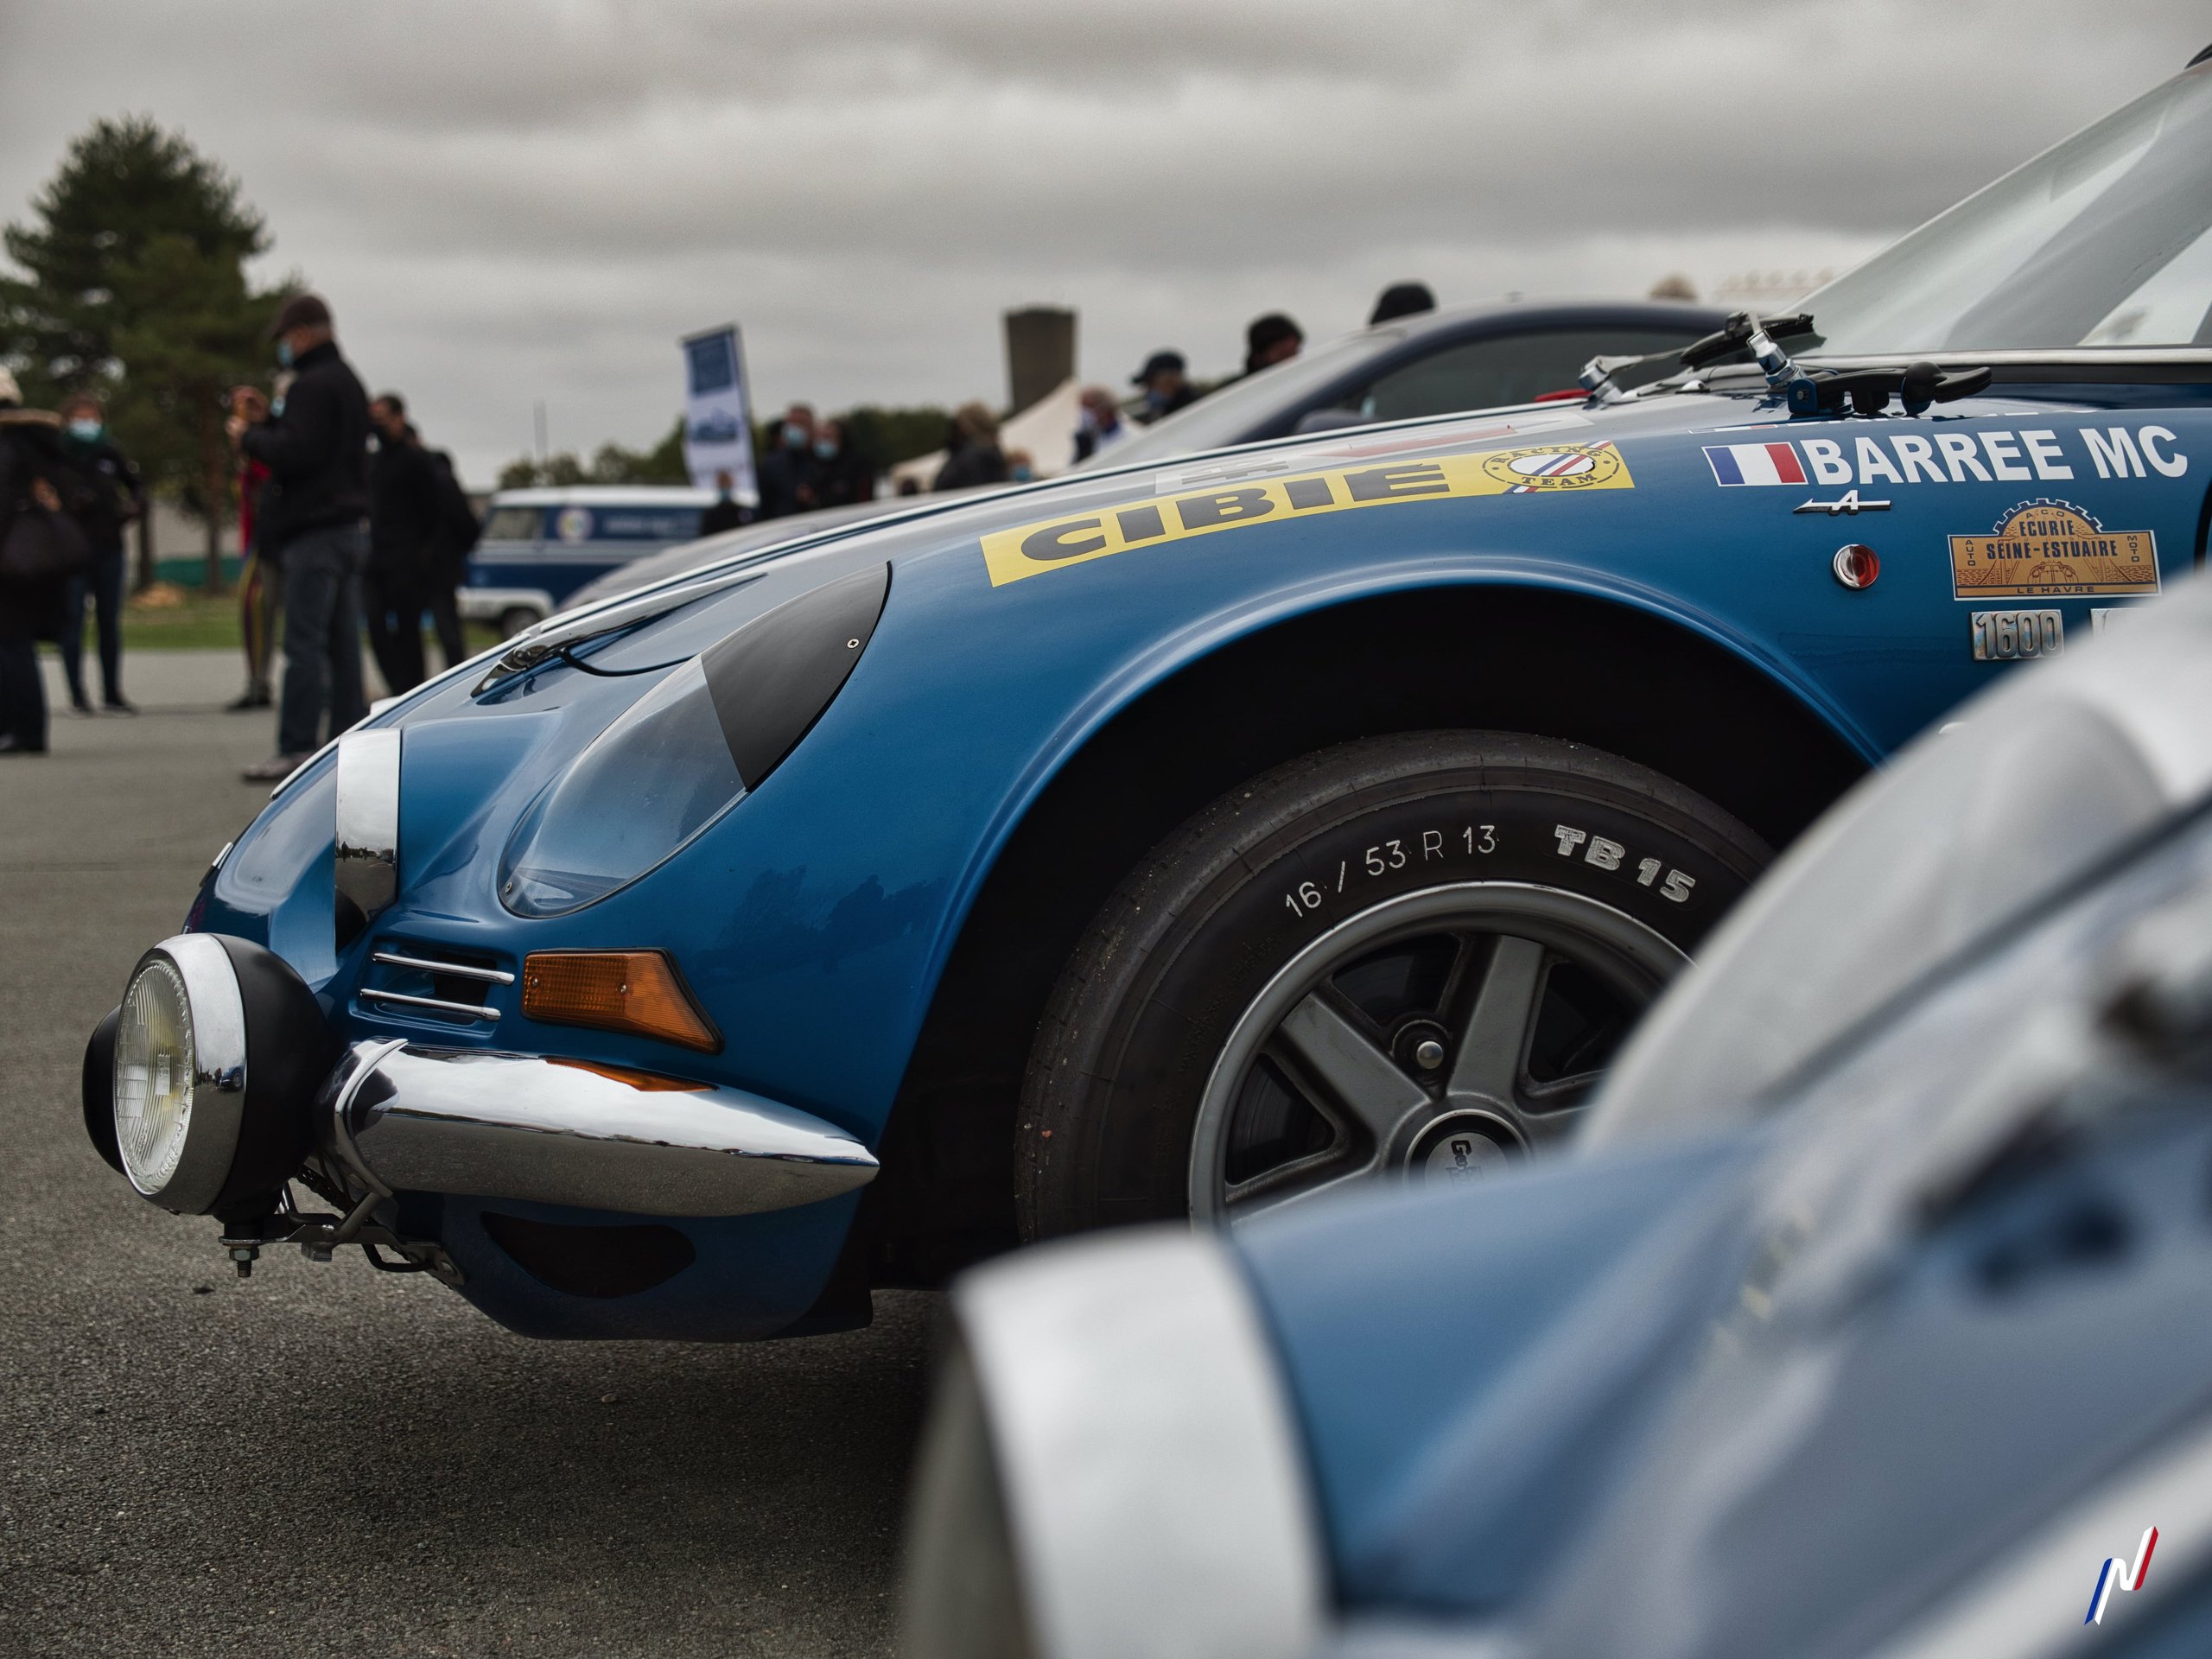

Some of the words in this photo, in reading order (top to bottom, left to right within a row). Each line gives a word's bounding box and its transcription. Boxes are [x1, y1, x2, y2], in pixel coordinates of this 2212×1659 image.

[1490, 446, 1602, 463] RACING
[1800, 429, 2074, 486] BARREE
[2078, 425, 2189, 479] MC
[1522, 474, 1598, 486] TEAM
[1020, 464, 1451, 562] CIBIE
[2018, 519, 2075, 537] ECURIE
[1965, 539, 1976, 567] AUTO
[2126, 535, 2140, 563] MOTO
[1976, 611, 2063, 658] 1600
[1285, 881, 1322, 918] 16
[1365, 839, 1407, 876] 53
[1422, 830, 1444, 861] R
[1462, 824, 1496, 854] 13
[1554, 823, 1626, 871] TB
[1636, 856, 1696, 903] 15
